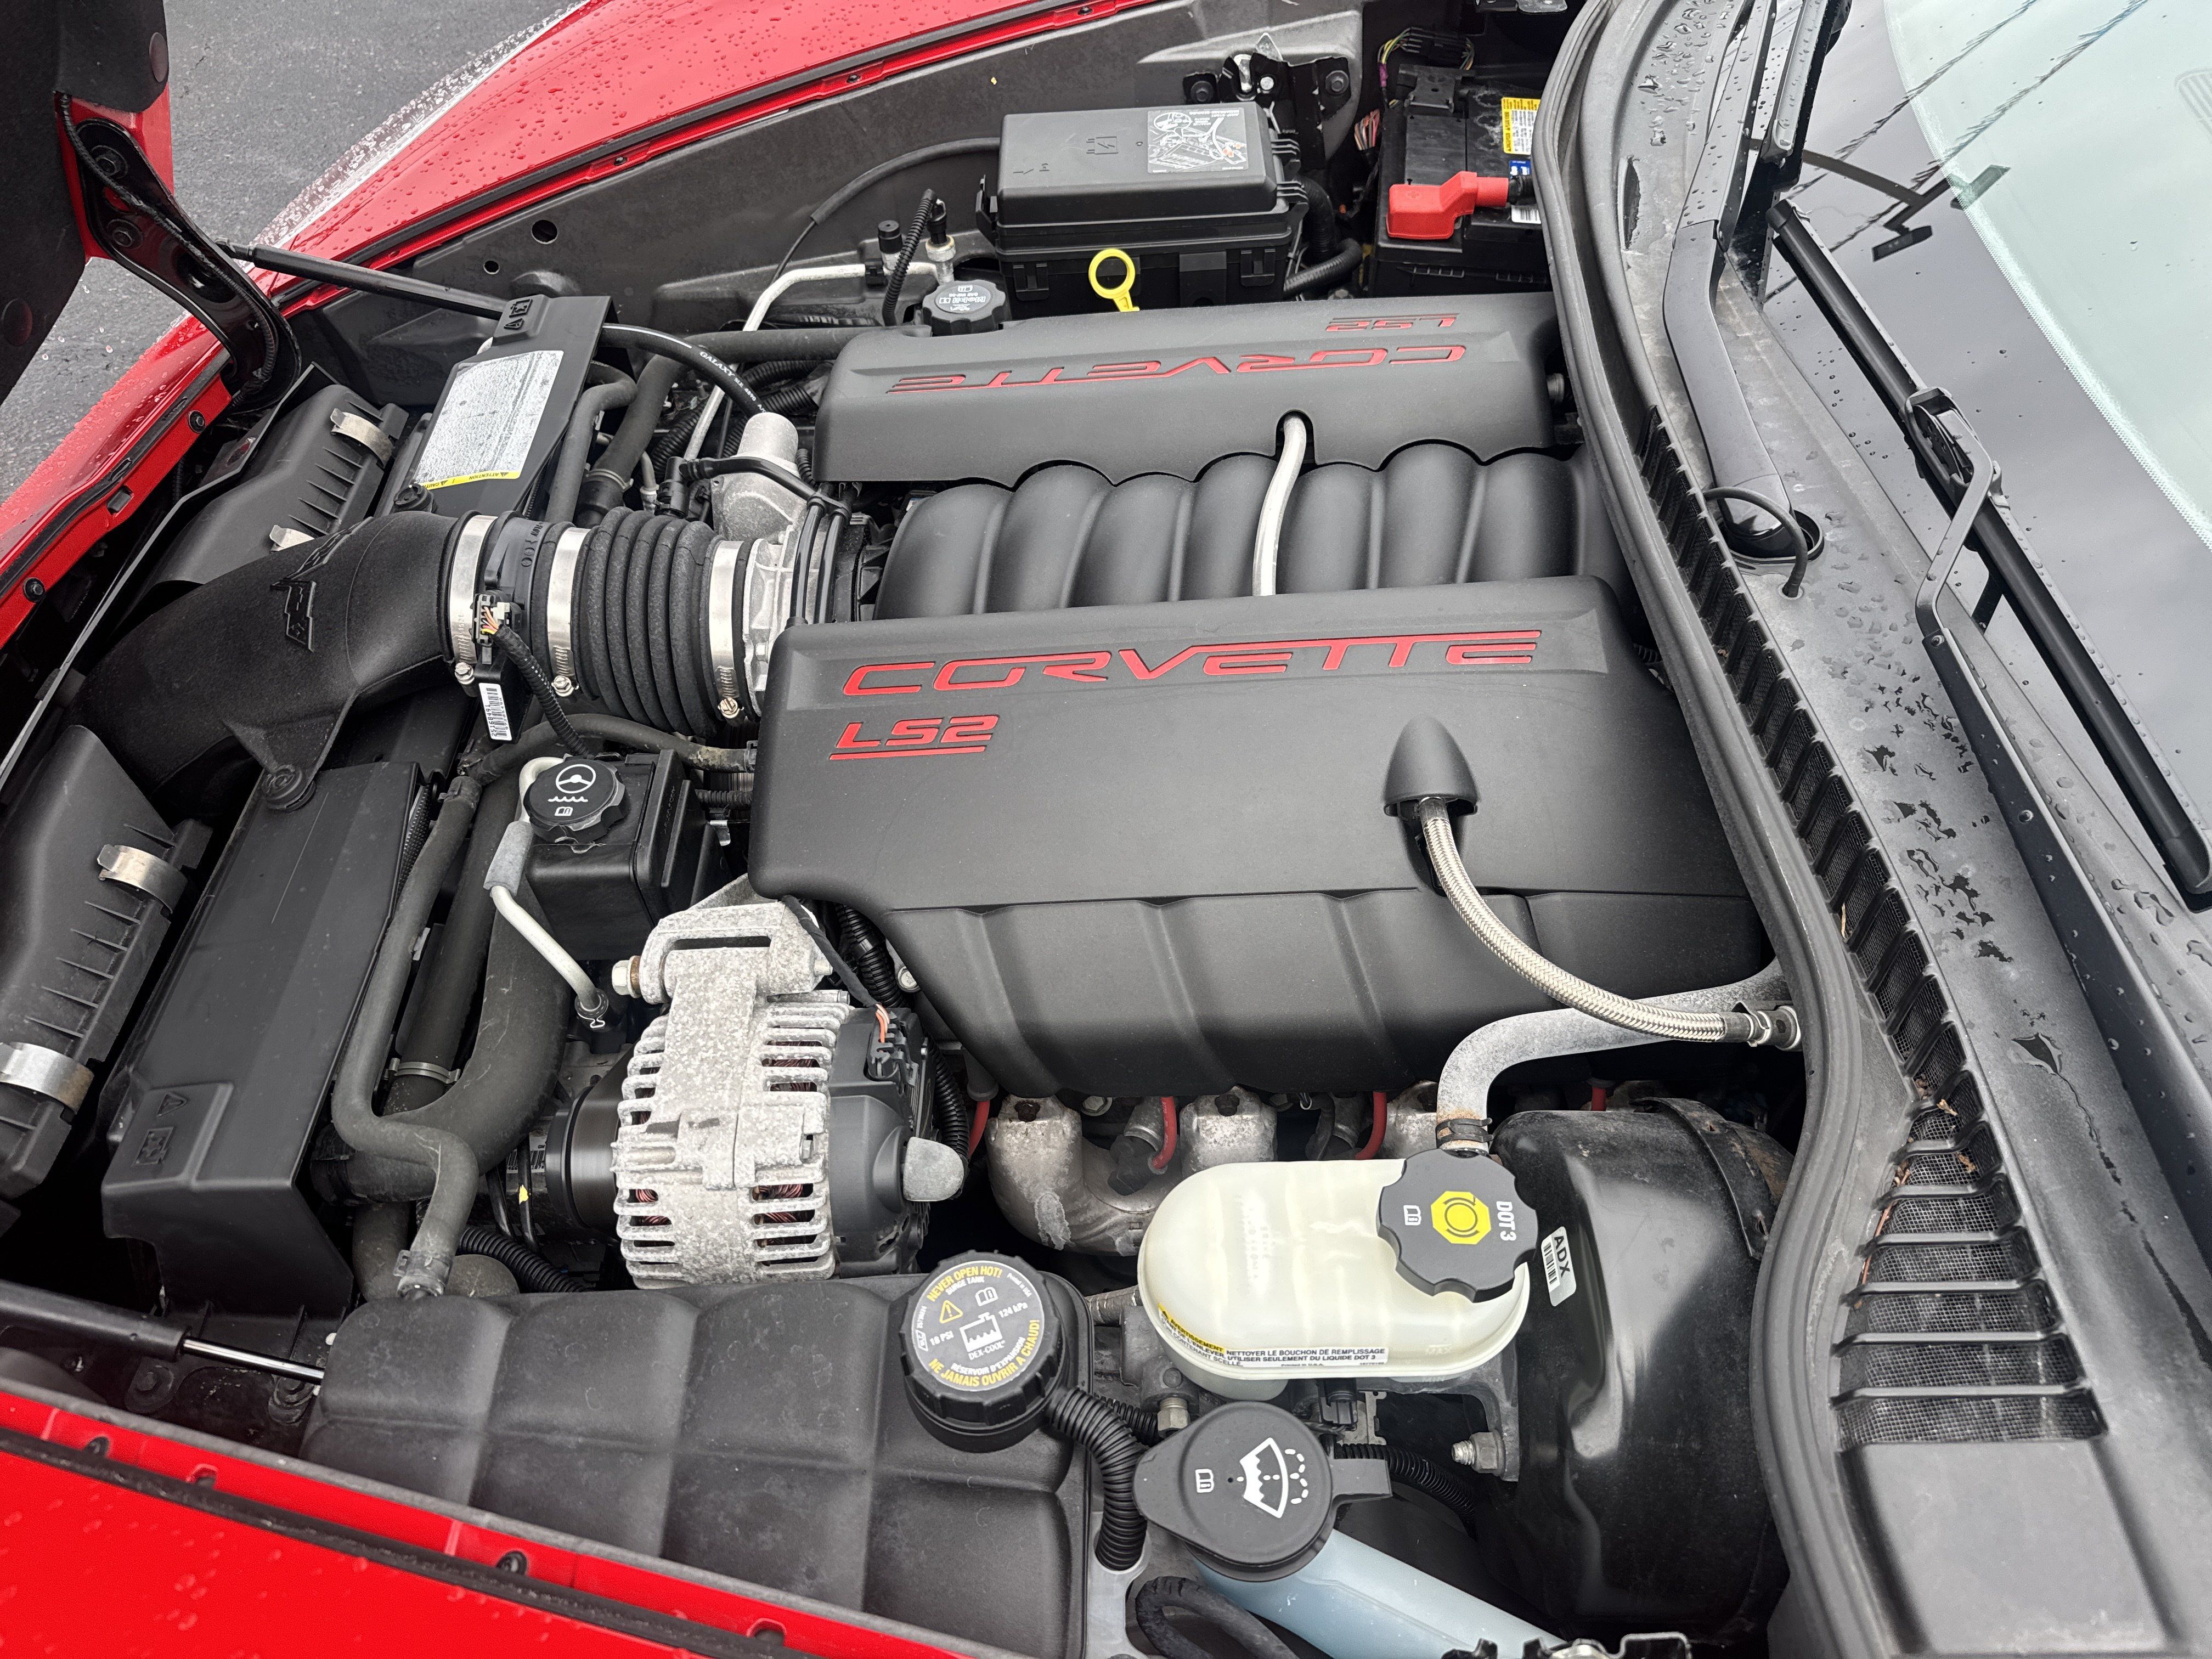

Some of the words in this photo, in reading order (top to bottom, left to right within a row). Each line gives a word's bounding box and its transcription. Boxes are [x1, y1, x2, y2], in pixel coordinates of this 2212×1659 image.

[1326, 314, 1459, 331] LS2
[699, 351, 735, 376] GALAXY
[887, 344, 1466, 394] CORVETTE
[842, 630, 1542, 696] CORVETTE
[485, 705, 497, 737] 25168491
[836, 714, 1000, 749] LS2
[1496, 1201, 1515, 1230] DOT
[1500, 1231, 1516, 1241] 3
[1554, 1235, 1570, 1278] ADX
[927, 1275, 955, 1302] NEVER
[953, 1266, 979, 1281] OPEN
[980, 1265, 1003, 1278] HOT!
[945, 1279, 967, 1295] SURGE
[966, 1276, 984, 1284] TANK
[998, 1308, 1013, 1318] 124
[1013, 1302, 1028, 1313] kPa
[930, 1335, 940, 1346] 18
[939, 1330, 954, 1342] PSI
[1171, 1319, 1223, 1352] AVERTISSEMENT
[928, 1358, 944, 1374] NE
[940, 1369, 980, 1387] JAMAIS
[981, 1362, 1019, 1386] OUVRIR
[1020, 1319, 1040, 1357] CHAUD!
[990, 1336, 1025, 1372] D'EXPANSION
